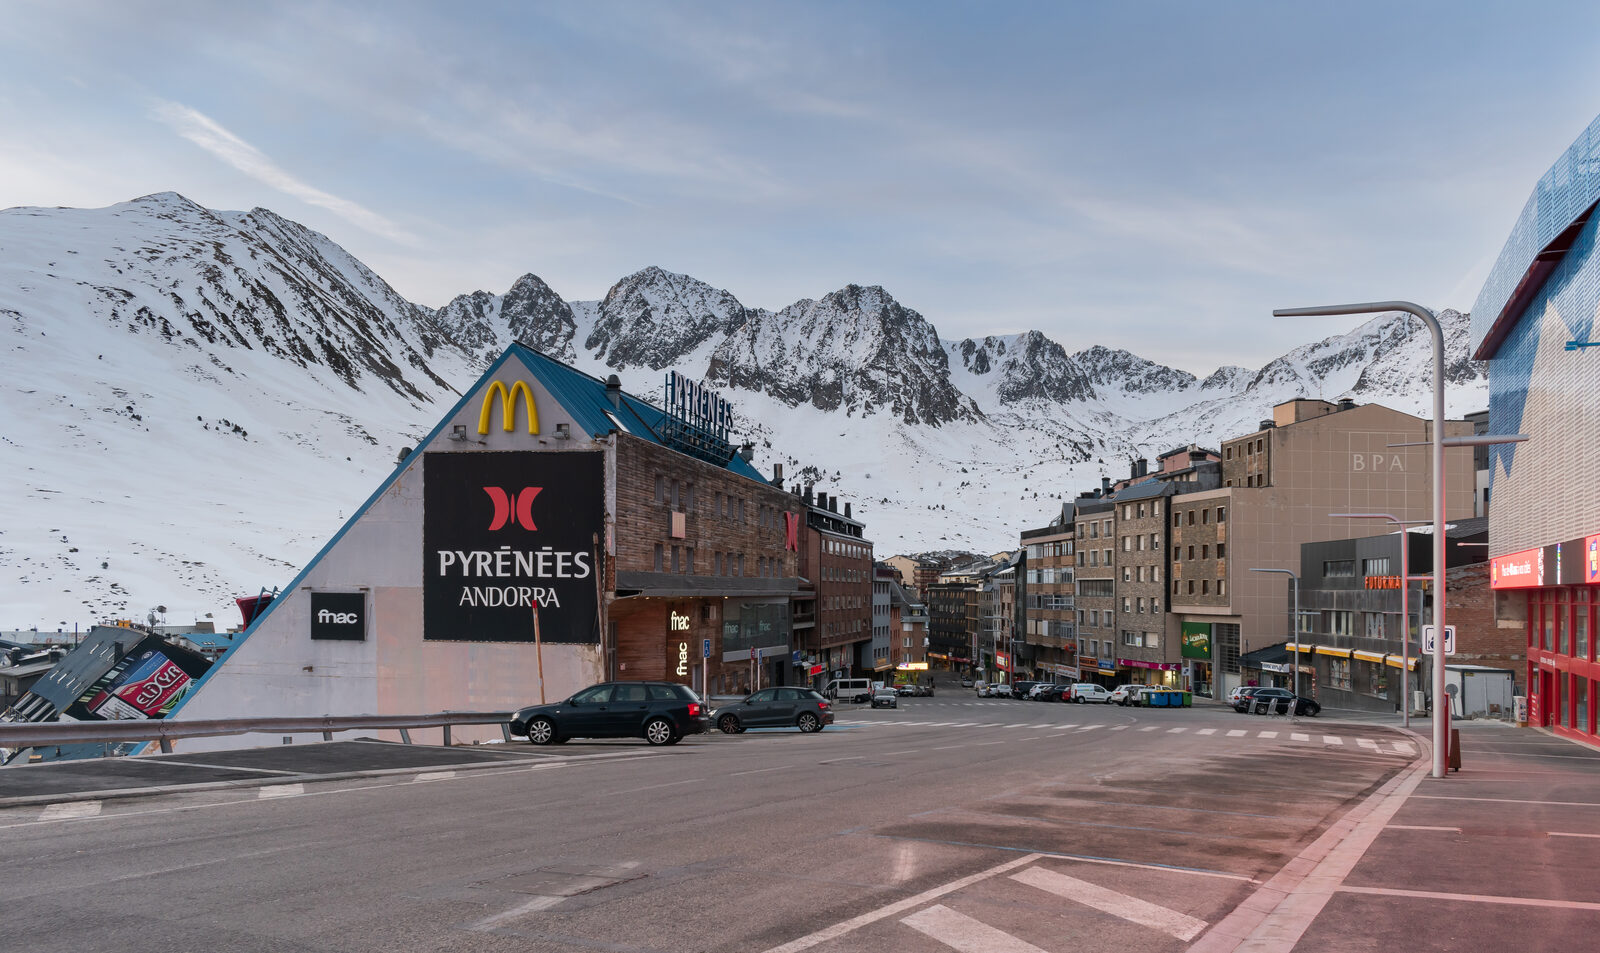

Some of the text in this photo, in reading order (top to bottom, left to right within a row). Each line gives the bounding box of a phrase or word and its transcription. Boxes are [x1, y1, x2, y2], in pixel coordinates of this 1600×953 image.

[1364, 575, 1411, 590] FUTURMA
[459, 586, 561, 608] ANDORRA
[317, 608, 358, 625] fnac
[670, 610, 690, 631] fnac
[676, 642, 688, 677] fnac
